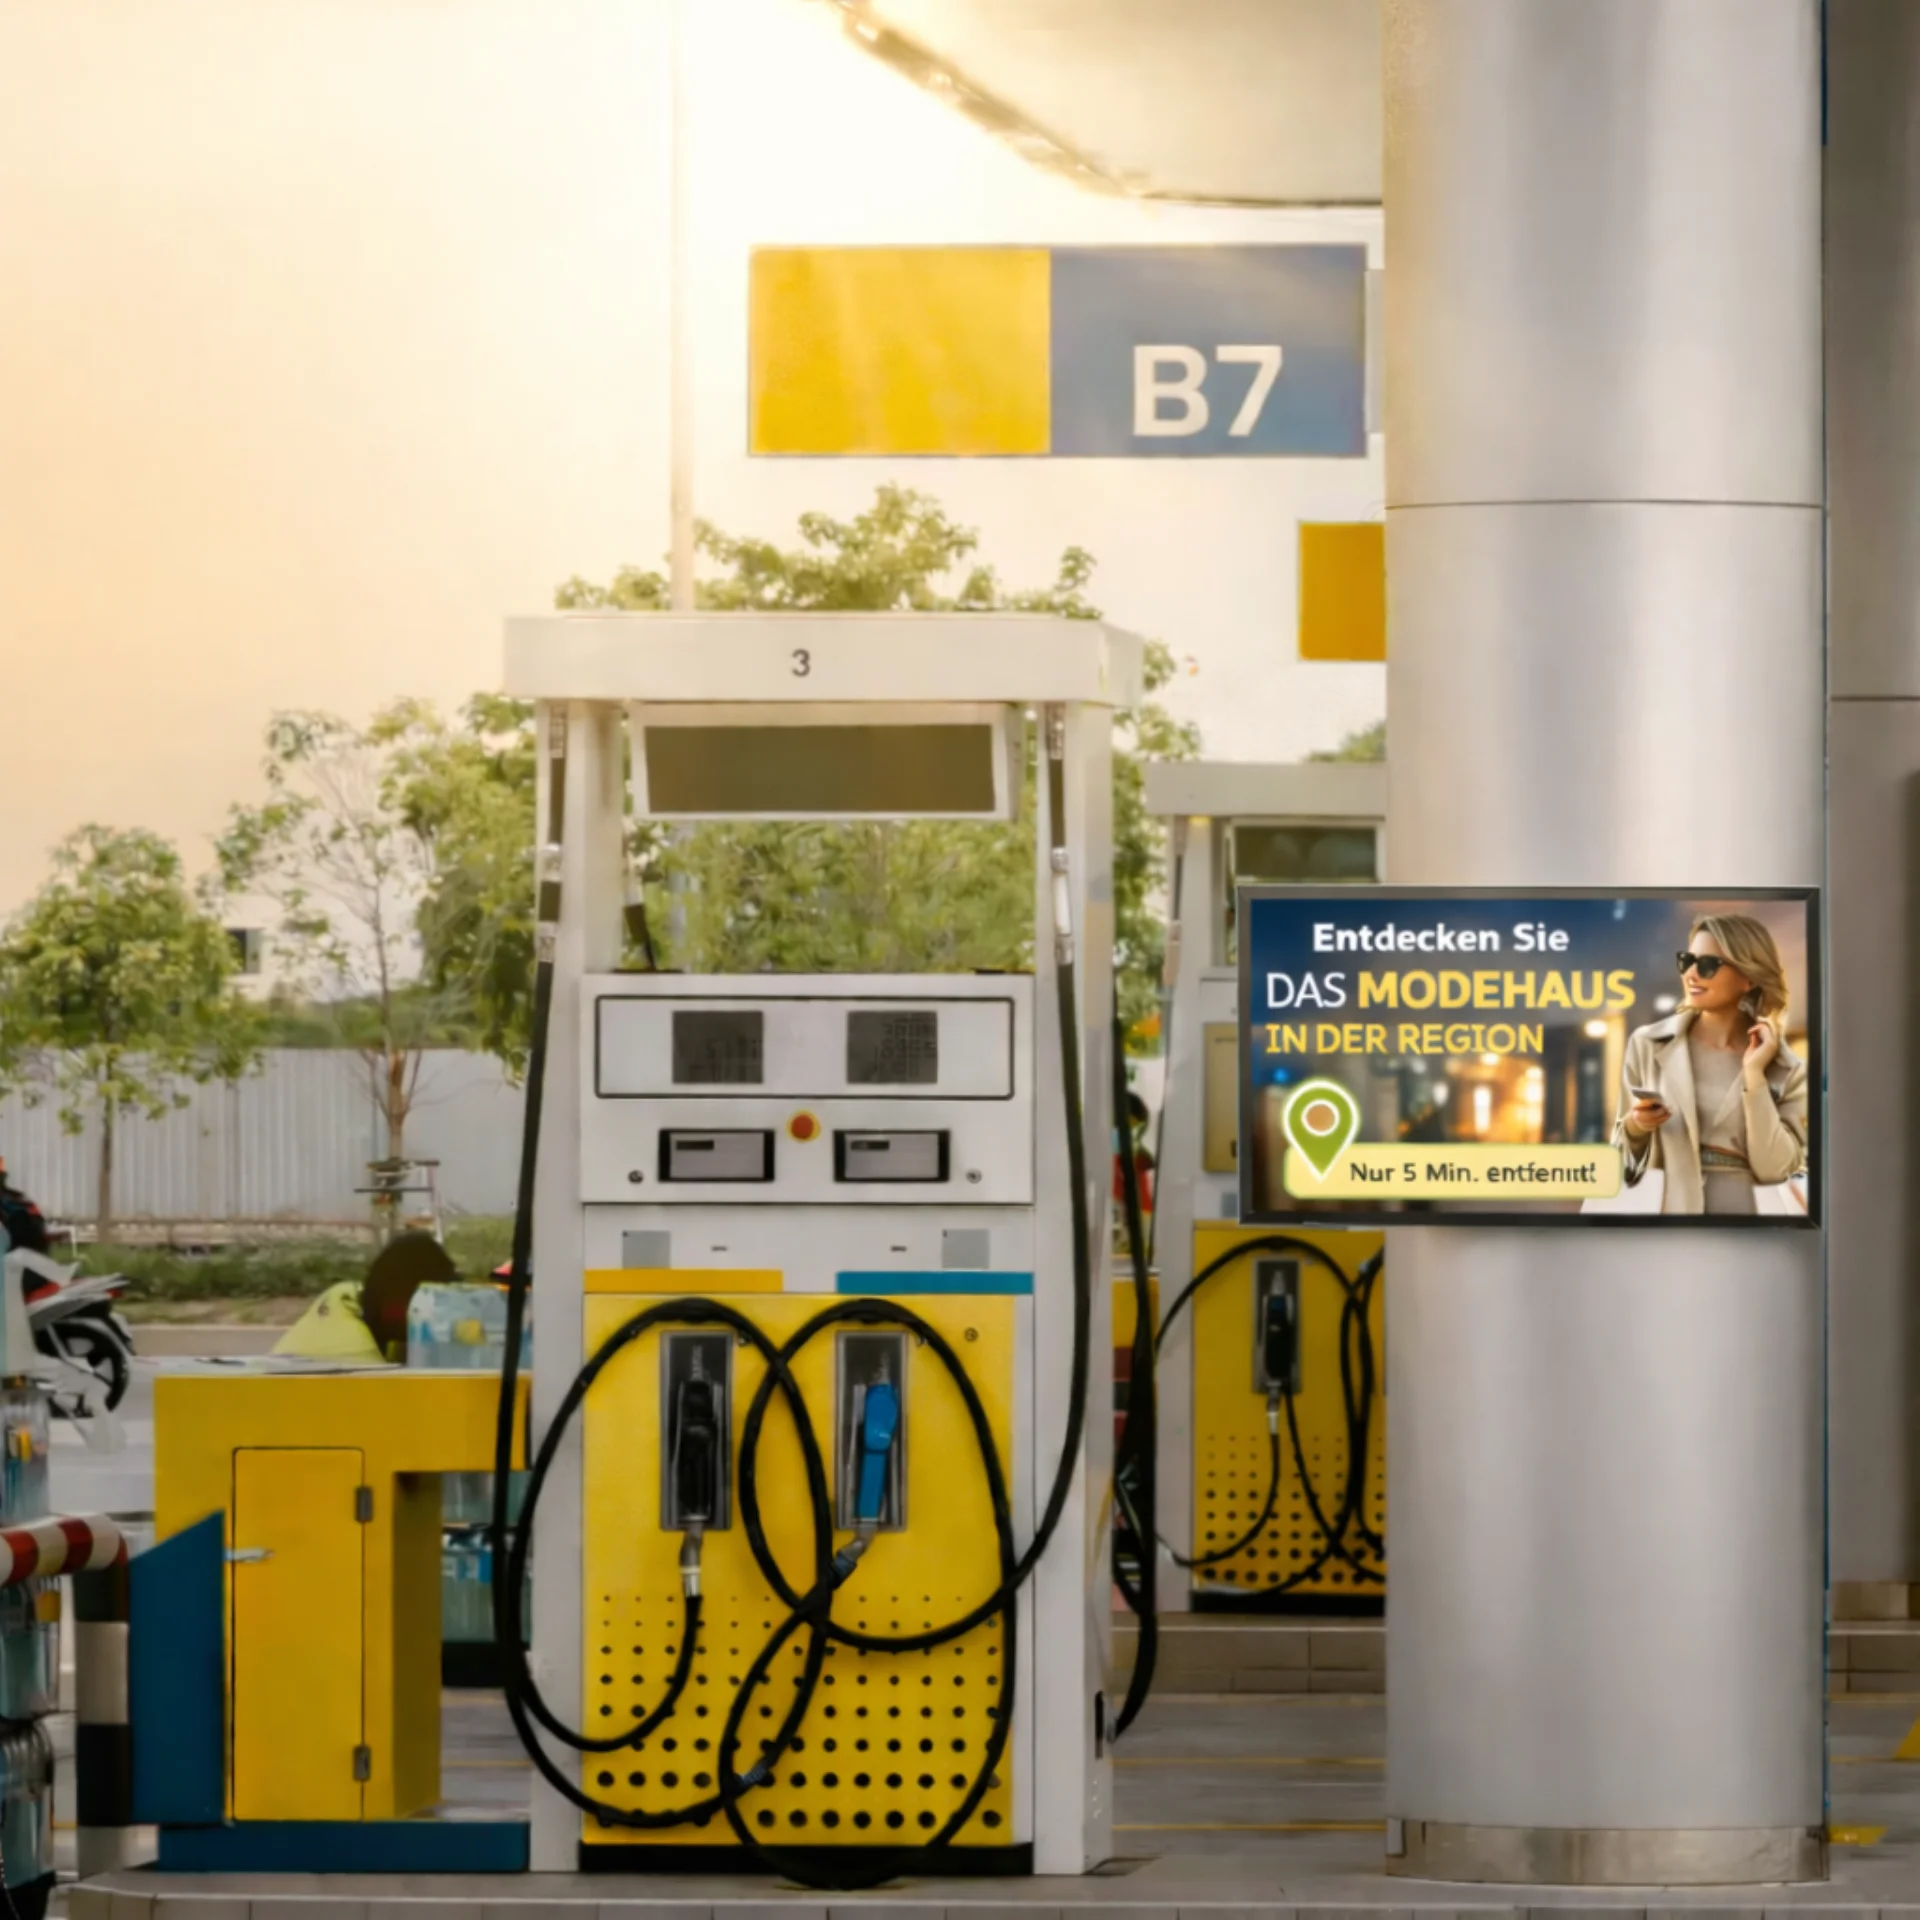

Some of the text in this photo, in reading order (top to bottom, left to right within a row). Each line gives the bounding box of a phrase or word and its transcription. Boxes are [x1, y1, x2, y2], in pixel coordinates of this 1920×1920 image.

[1132, 344, 1283, 437] B7
[791, 649, 811, 677] 3
[1312, 922, 1570, 953] Entdecken Sie
[1266, 969, 1636, 1010] DAS MODEHAUS
[1265, 1023, 1544, 1056] IN DER REGION
[1350, 1162, 1394, 1183] Nur
[1403, 1162, 1417, 1183] 5
[1426, 1162, 1479, 1183] Min.
